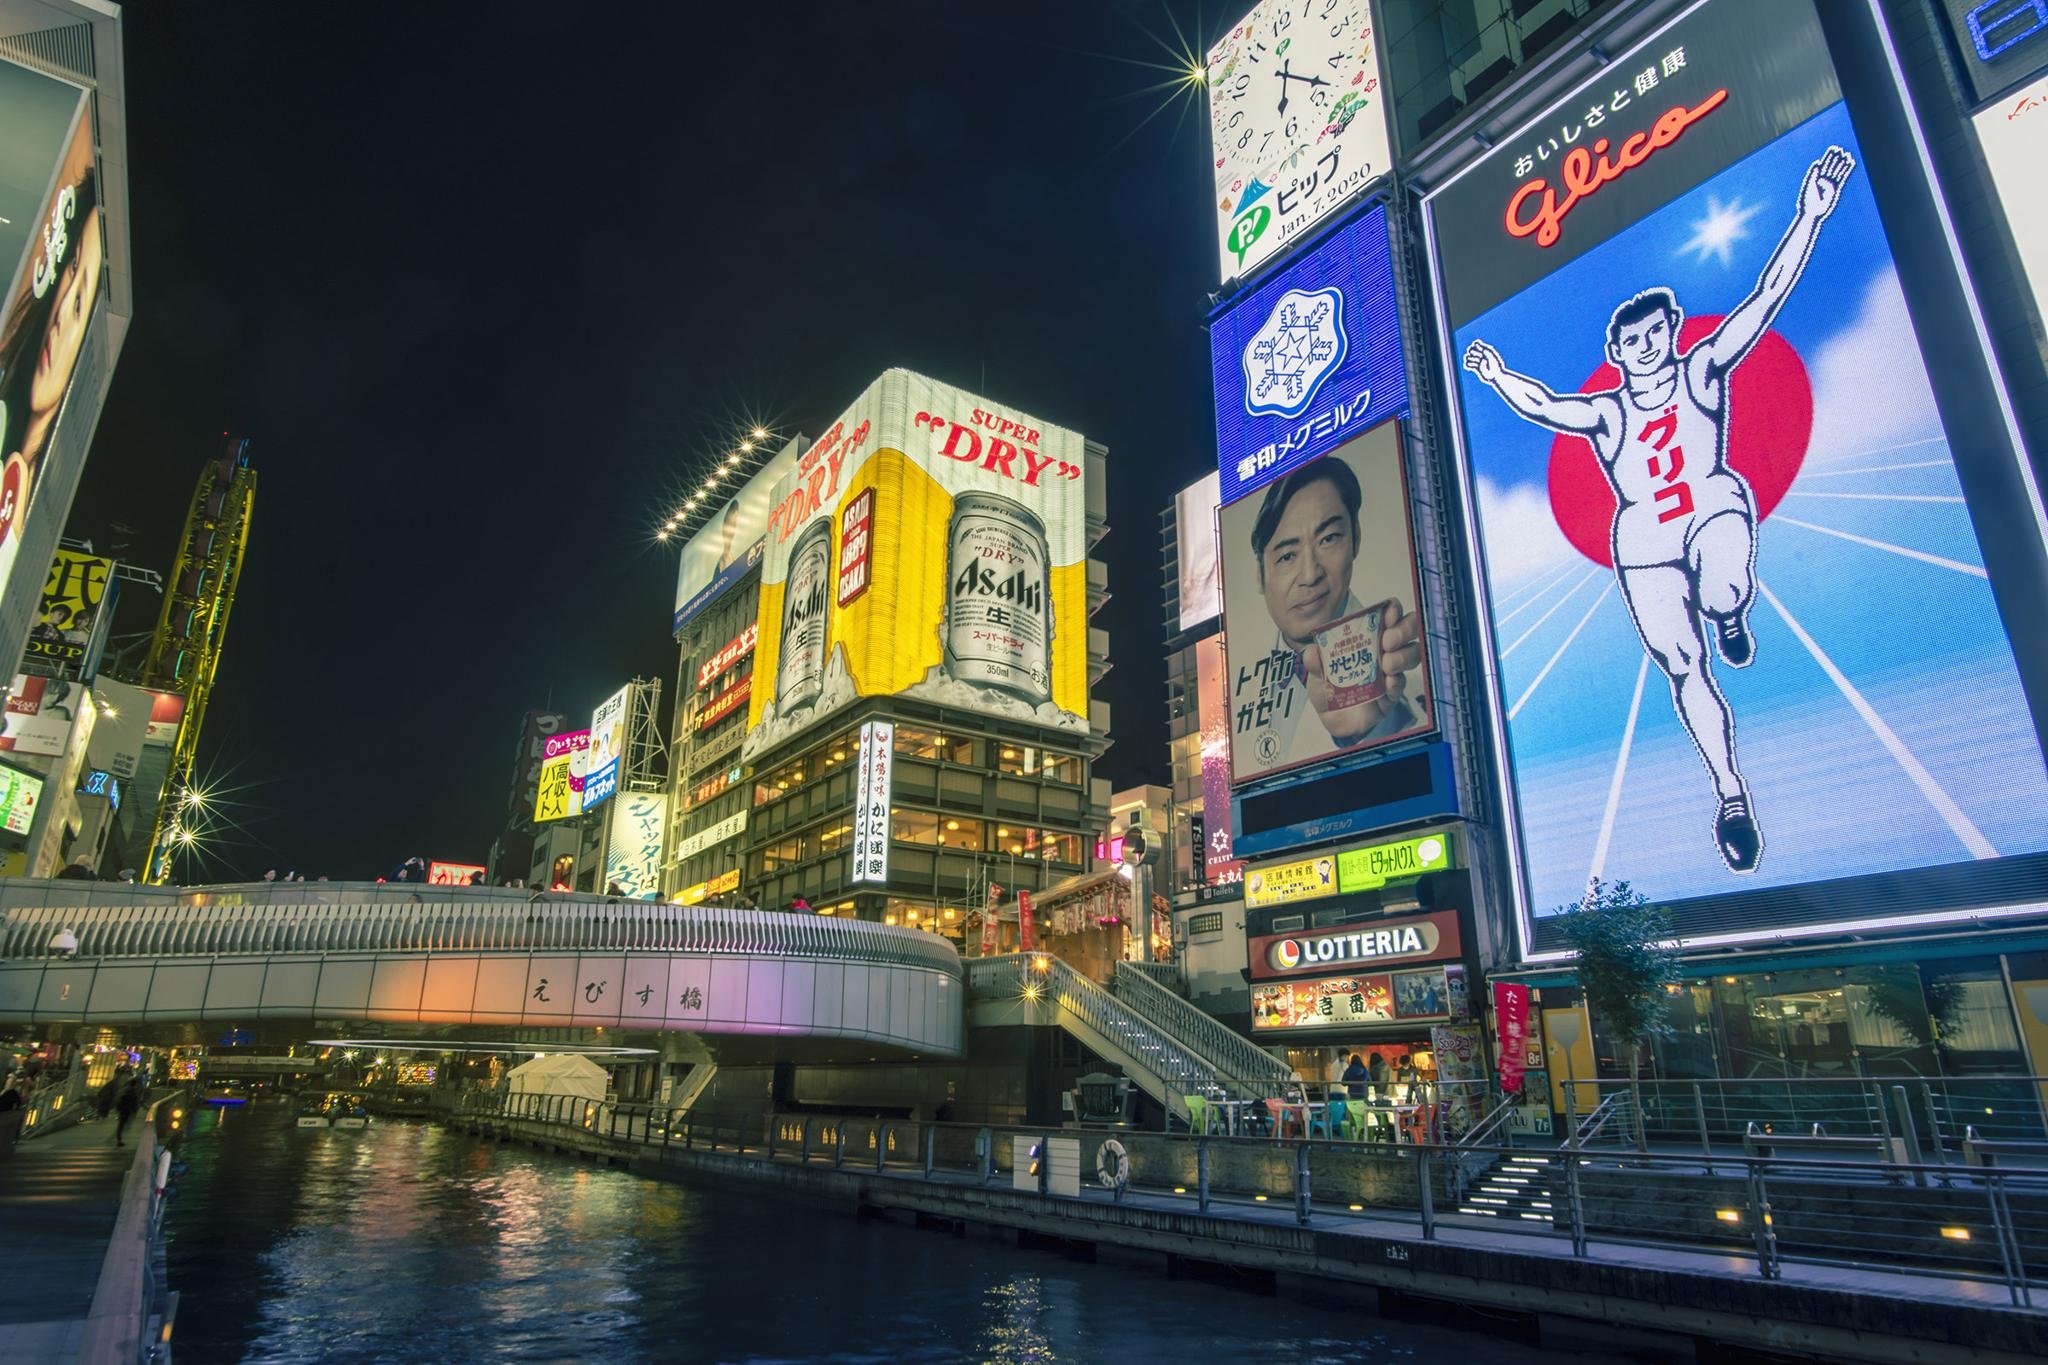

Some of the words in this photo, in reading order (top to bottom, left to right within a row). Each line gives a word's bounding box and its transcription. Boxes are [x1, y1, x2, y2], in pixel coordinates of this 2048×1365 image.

[1272, 11, 1291, 37] 12
[1331, 16, 1349, 37] 3
[1248, 40, 1267, 63] 11
[1328, 51, 1345, 69] 4
[1231, 74, 1251, 102] 10
[1310, 88, 1326, 107] 5
[1228, 111, 1244, 128] 9
[1513, 45, 1690, 178] おいしさと健康
[1237, 128, 1253, 150] 8
[1260, 131, 1274, 152] 7
[1284, 116, 1298, 138] 6
[1277, 145, 1342, 216] ピップ
[1505, 89, 1728, 247] Glico
[1277, 214, 1311, 240] Jan.
[1313, 197, 1325, 212] 7.
[1327, 162, 1371, 202] 2020
[970, 408, 1041, 447] SUPER
[1237, 389, 1371, 481] 雪印メグミルク
[798, 422, 843, 480] SUPER
[1637, 404, 1695, 524] グリコ
[841, 530, 868, 572] 1889
[839, 561, 865, 602] OSAKA
[954, 557, 1041, 615] Asahi
[986, 605, 1012, 628] 生
[796, 630, 808, 650] 生
[973, 630, 1025, 651] スーパードライ
[986, 664, 1009, 678] 350ml
[1236, 650, 1296, 697] トクホ
[1259, 687, 1268, 698] の
[1236, 687, 1294, 734] ガセリ
[874, 747, 887, 798] 本場の味
[541, 767, 557, 818] バイト
[868, 801, 886, 876] かに道楽
[1370, 845, 1416, 875] ピタットハウス
[1213, 886, 1235, 898] Toilets
[1304, 927, 1422, 963] LOTTERIA
[533, 978, 703, 1012] えびす橋
[1319, 979, 1361, 994] たこやき
[1528, 1052, 1541, 1065] 8F
[1535, 1118, 1549, 1132] 7F
